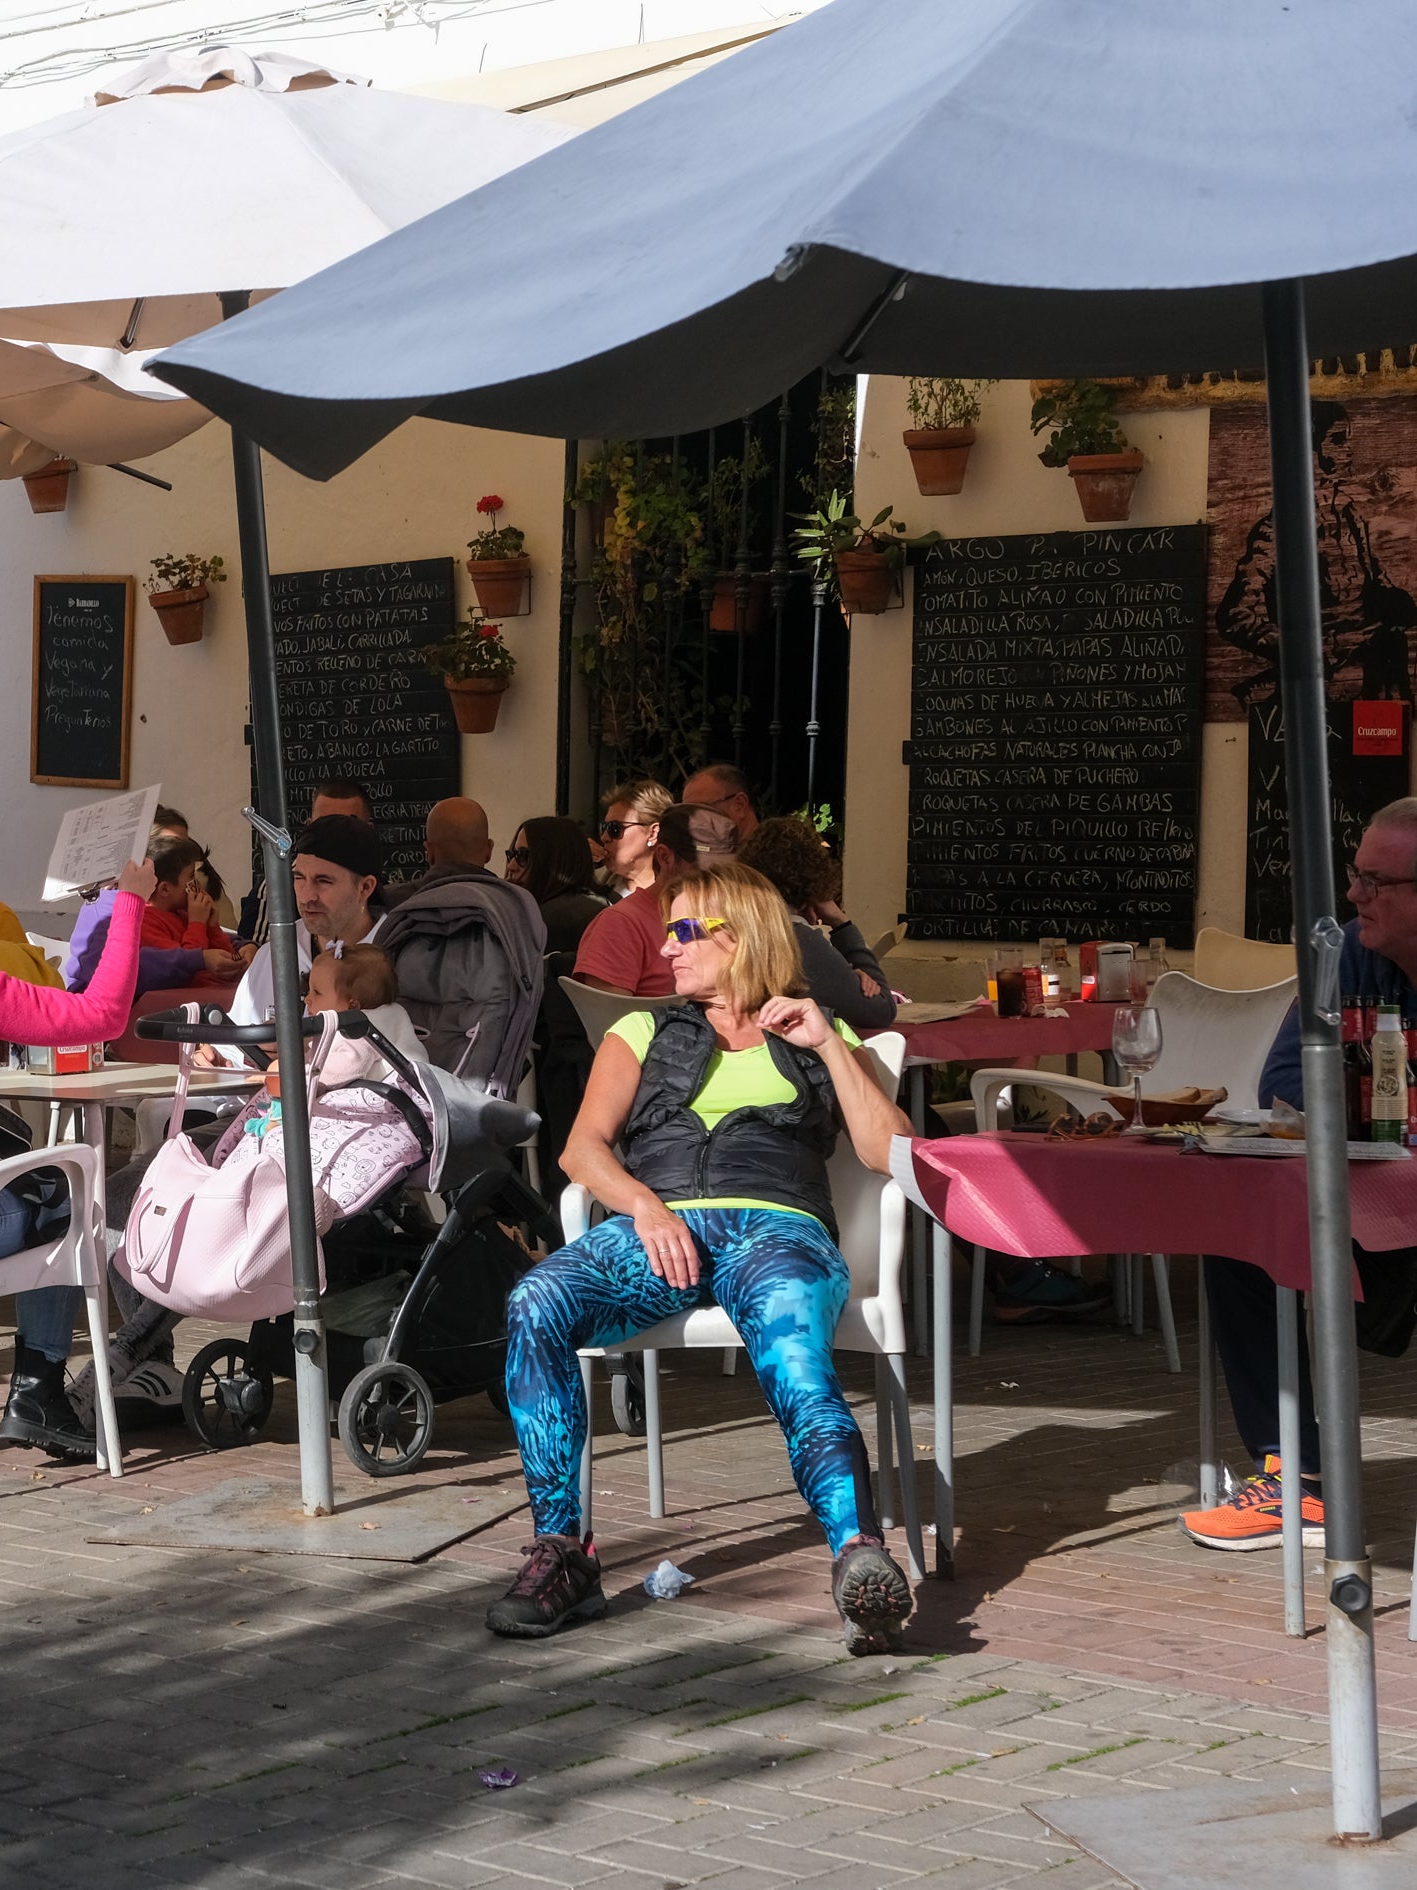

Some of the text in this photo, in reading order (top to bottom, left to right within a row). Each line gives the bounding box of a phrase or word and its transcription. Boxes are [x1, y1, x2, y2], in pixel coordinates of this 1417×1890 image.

[1075, 585, 1109, 605] CON
[337, 614, 361, 629] CON
[53, 629, 108, 650] comida
[367, 654, 382, 669] DE
[388, 649, 427, 665] CARN
[280, 694, 402, 717] ONDIGAS DE LOLA
[981, 693, 1000, 711] DE
[1358, 726, 1398, 738] Cruzcampo
[923, 768, 991, 787] ROQUETAS
[1054, 769, 1072, 786] DE
[922, 793, 999, 813] ROQUETAS
[1068, 793, 1092, 811] DE
[997, 870, 1016, 885] LA
